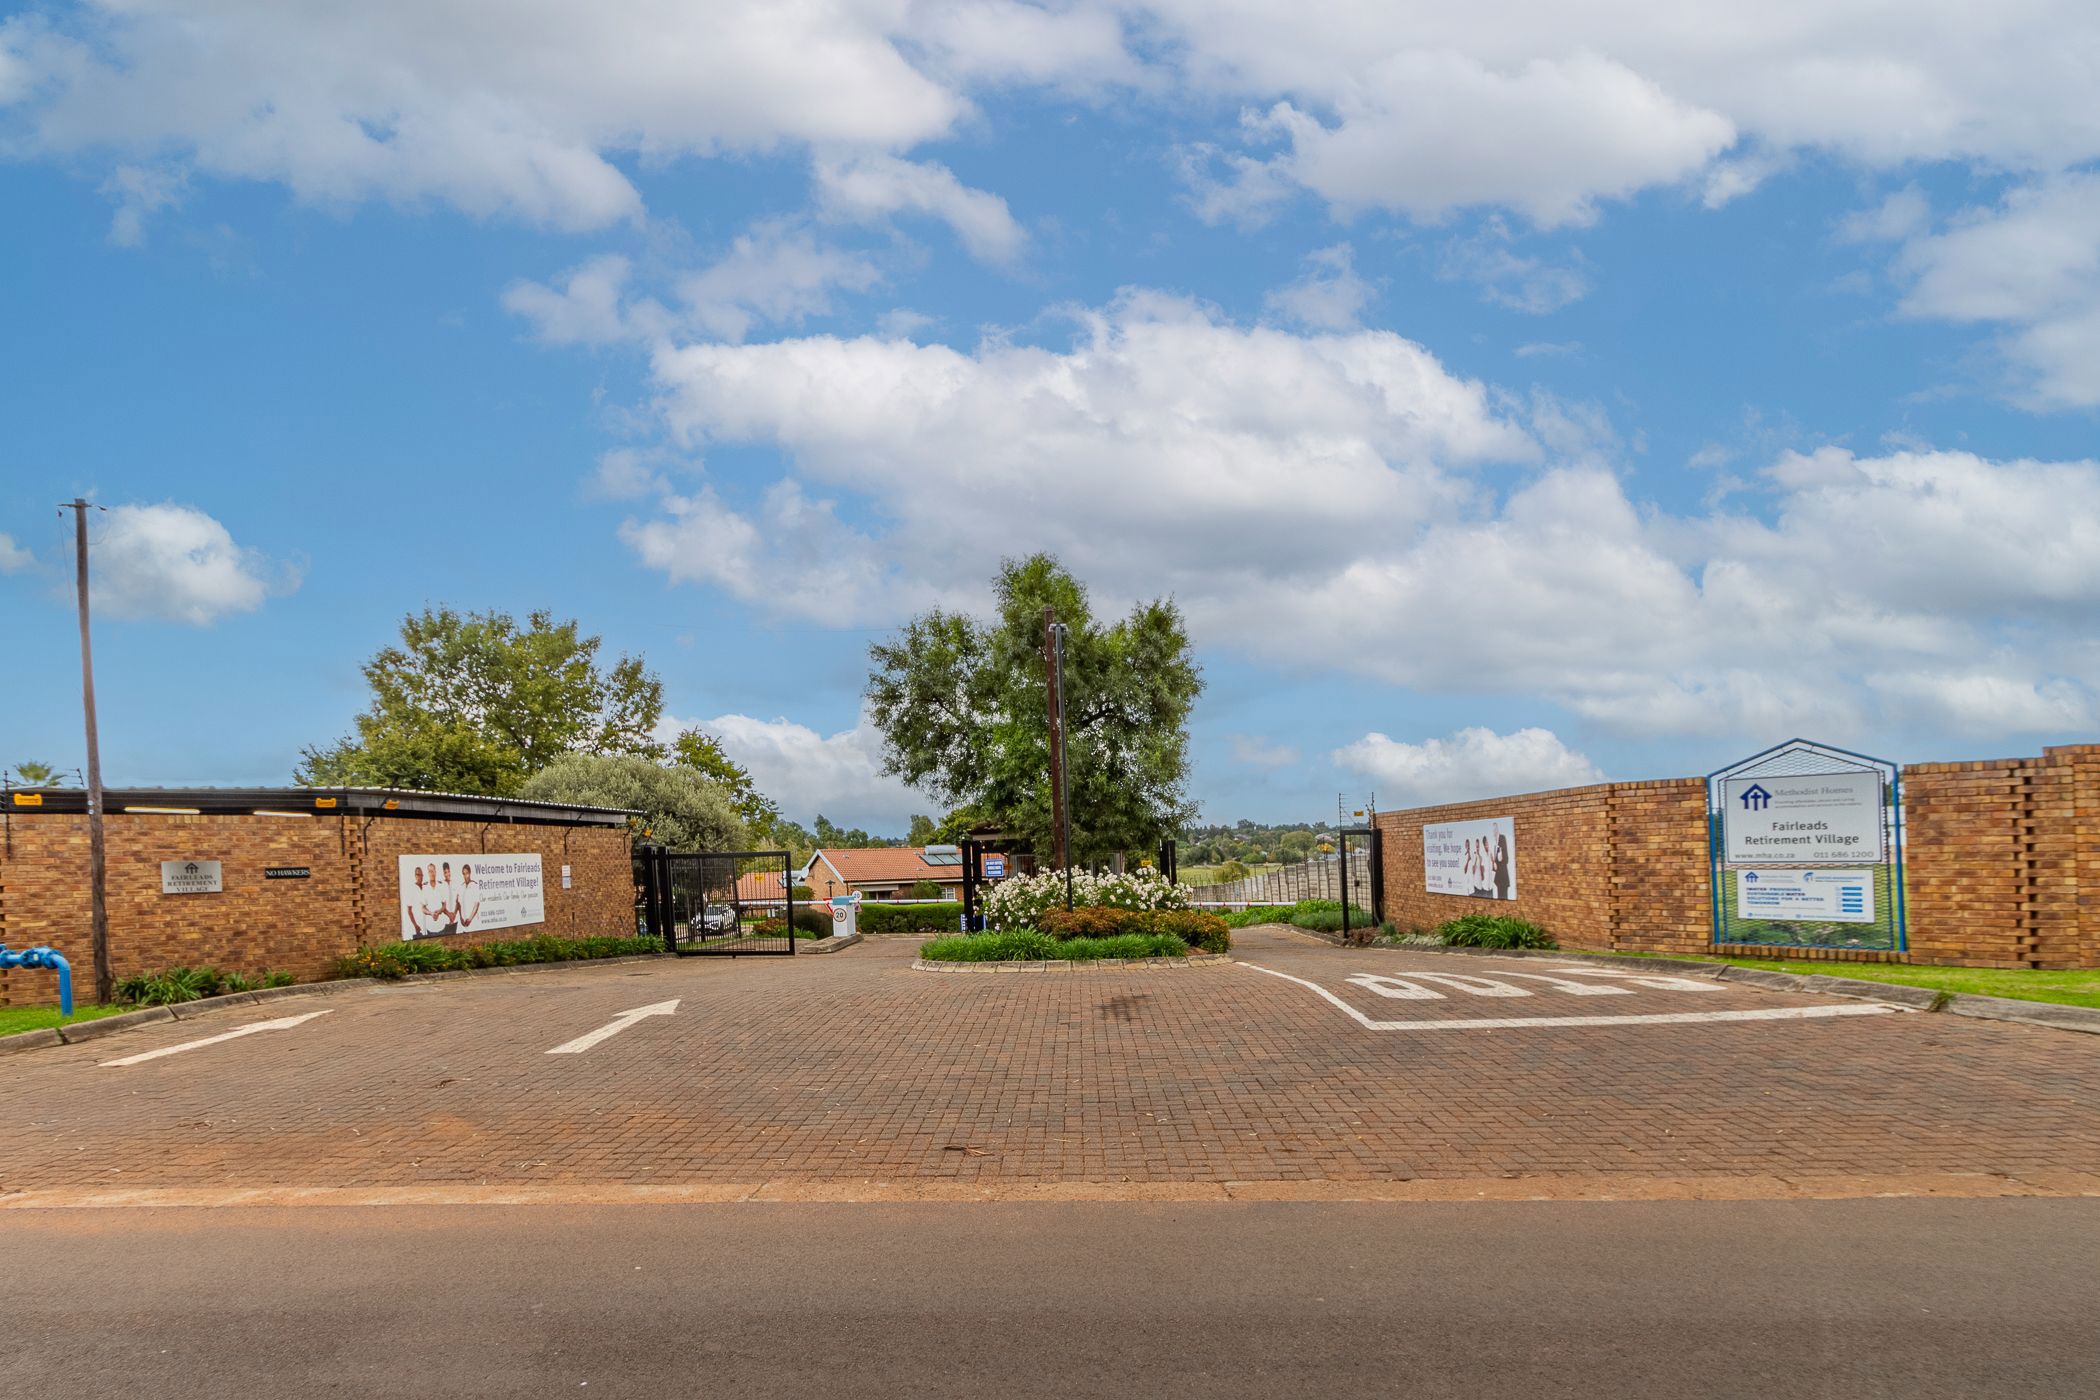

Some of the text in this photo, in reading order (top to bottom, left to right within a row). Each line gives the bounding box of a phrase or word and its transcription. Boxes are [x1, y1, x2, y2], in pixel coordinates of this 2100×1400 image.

[1774, 786, 1854, 797] Methodist Homes
[1772, 820, 1828, 831] Fairleads
[1745, 834, 1860, 846] Retirement Village
[1851, 850, 1874, 858] 1200
[474, 862, 541, 875] Welcome to Fairleads
[478, 876, 539, 890] Retirement Village!
